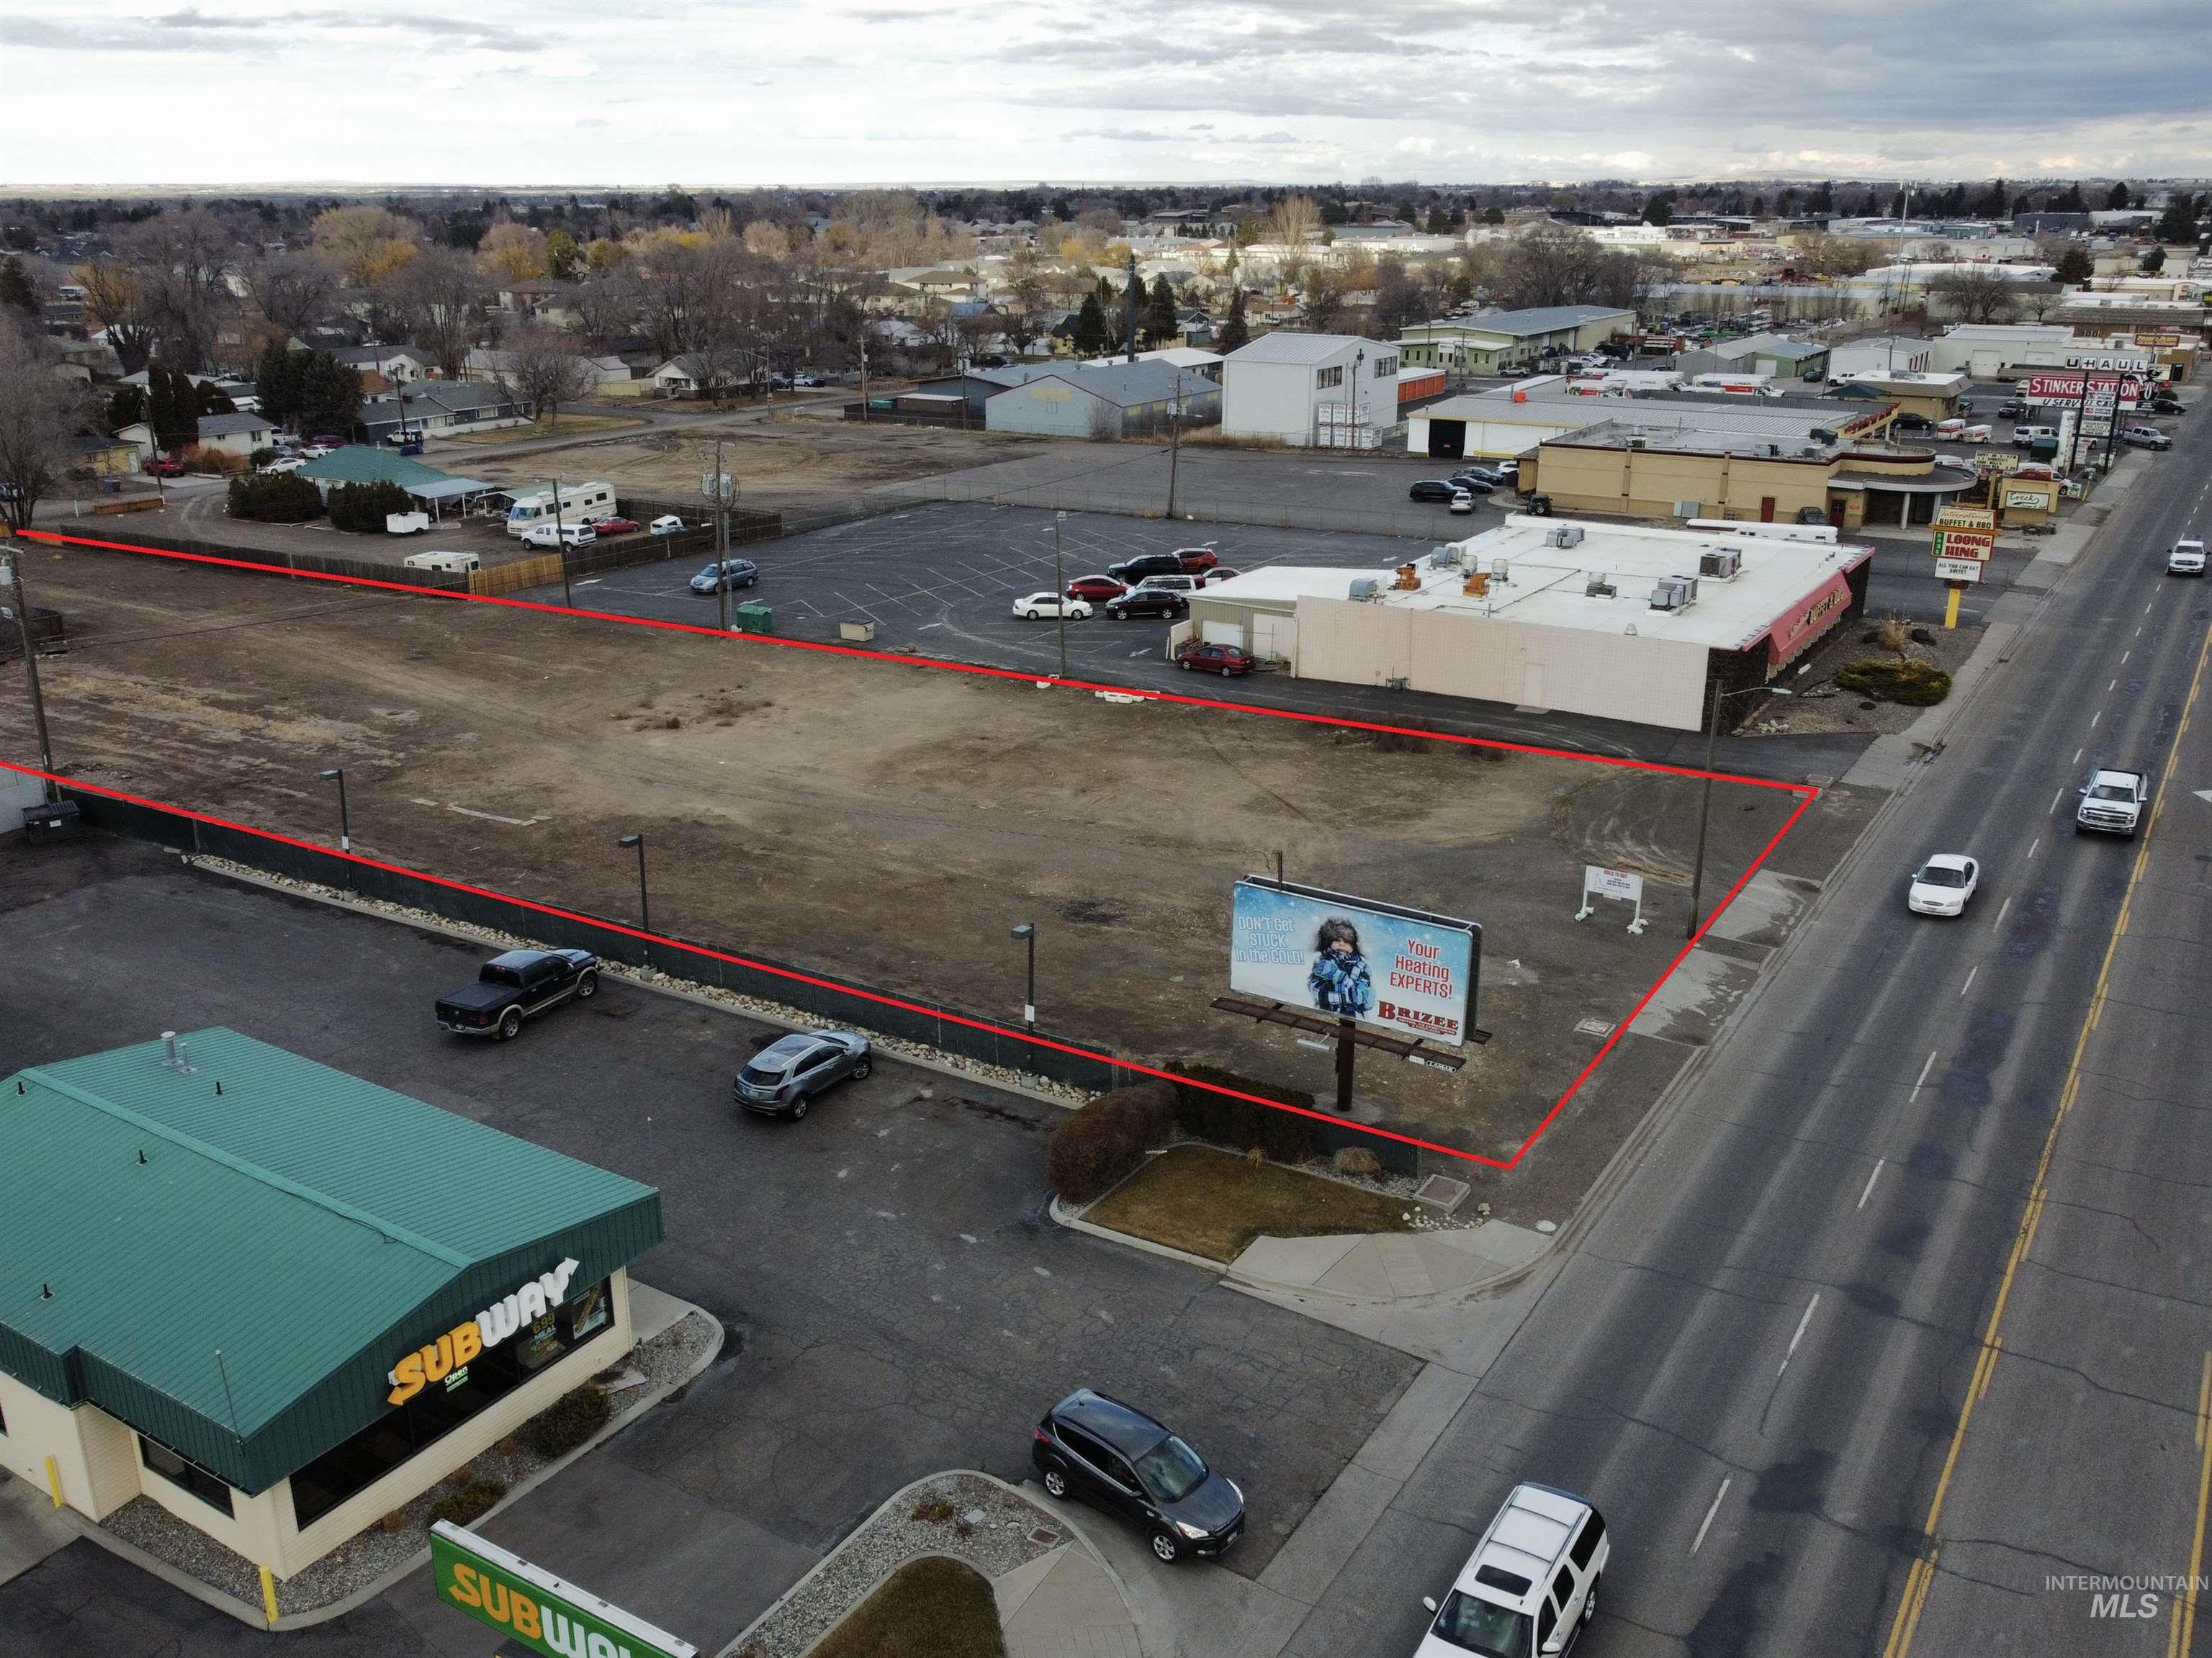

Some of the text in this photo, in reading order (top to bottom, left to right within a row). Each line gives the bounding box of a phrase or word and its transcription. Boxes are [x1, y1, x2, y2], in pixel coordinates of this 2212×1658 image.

[2031, 378, 2083, 395] STINKER
[1939, 518, 1966, 527] BUFFET
[1946, 533, 1990, 547] LOONG
[1945, 546, 1979, 558] HING
[1238, 916, 1295, 932] DON'T Get
[1249, 932, 1287, 948] STUCK
[1236, 947, 1305, 965] in the COLD!
[1408, 939, 1439, 960] Your
[1395, 955, 1449, 983] Heating
[1390, 971, 1452, 1000] EXPERTS!
[1377, 1000, 1459, 1030] BRIZEE
[387, 1257, 579, 1406] SUBWAY
[444, 1366, 468, 1384] Open
